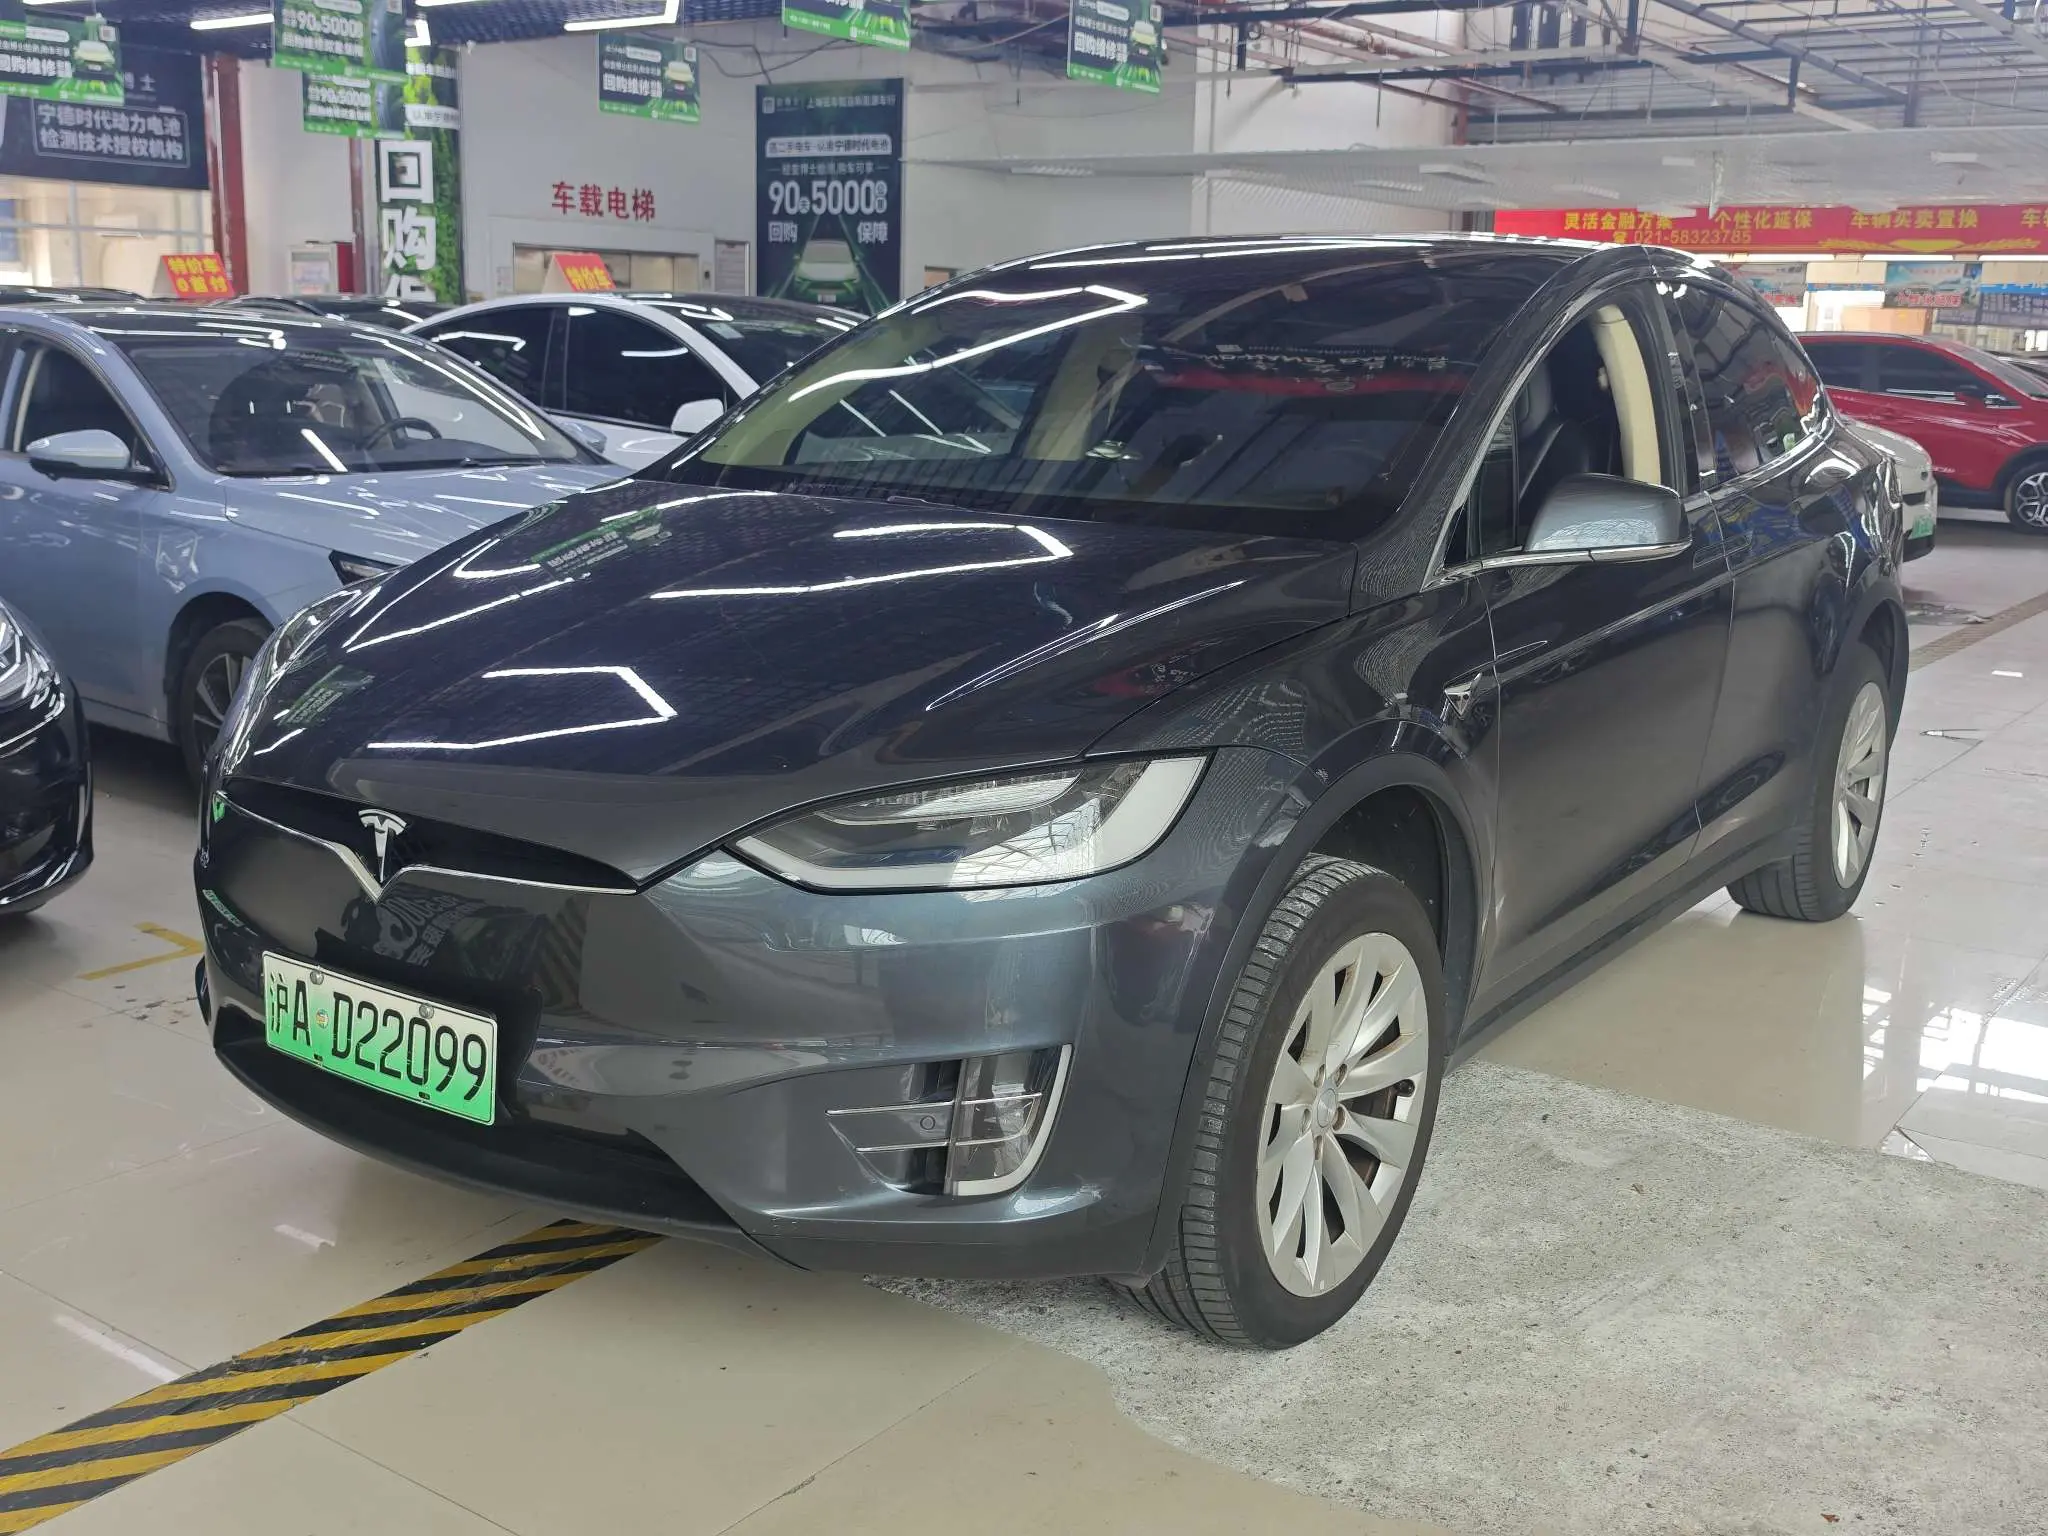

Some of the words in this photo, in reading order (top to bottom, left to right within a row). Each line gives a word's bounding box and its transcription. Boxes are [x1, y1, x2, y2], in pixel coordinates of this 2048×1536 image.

[37, 104, 182, 137] 宁德时代动力电池
[40, 128, 184, 160] 检测技术授权机构
[551, 181, 656, 222] 车载电梯
[768, 222, 798, 243] 回购
[857, 221, 888, 244] 保障
[1715, 209, 1813, 230] 个性化延保
[1851, 209, 1979, 229] 车辆买卖置换
[2020, 207, 2048, 229] 车
